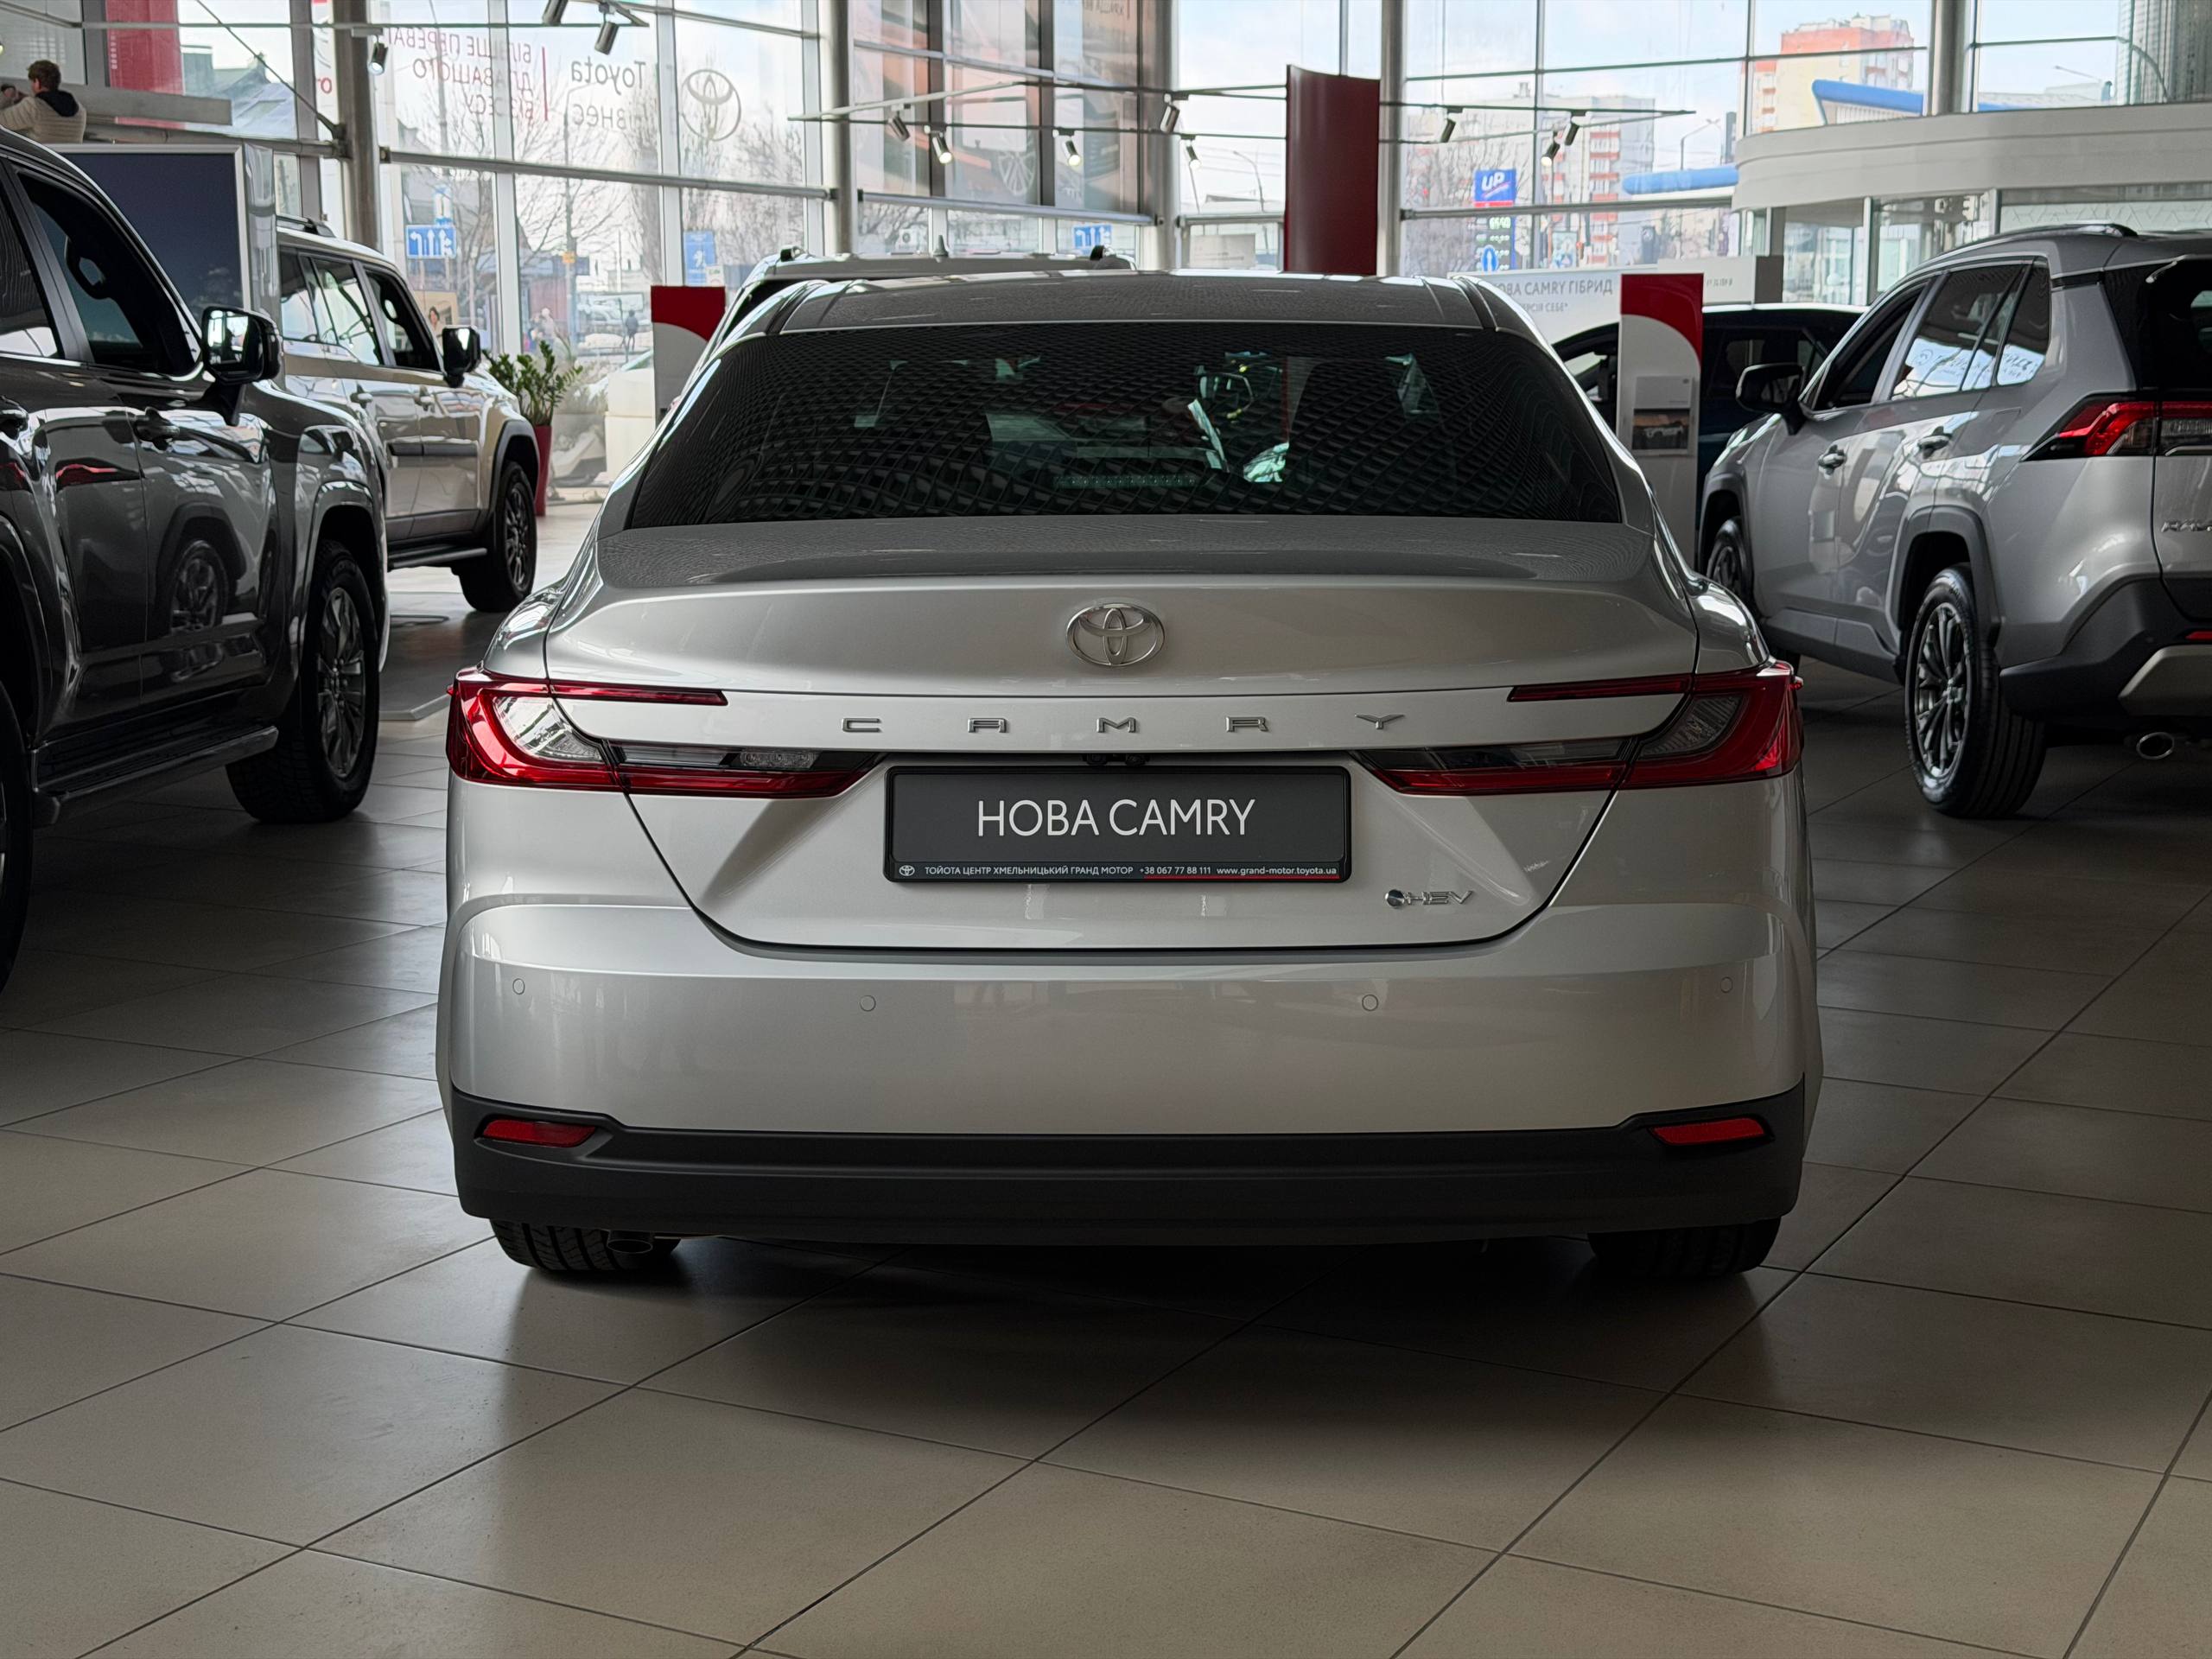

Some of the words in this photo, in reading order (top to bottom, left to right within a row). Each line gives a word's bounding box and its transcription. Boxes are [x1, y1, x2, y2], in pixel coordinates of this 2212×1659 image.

[1524, 280, 1567, 295] CAMRY
[1568, 278, 1613, 295] ГІБРИД
[842, 713, 1405, 734] CAMRY
[978, 799, 1100, 837] НОВА
[1109, 798, 1255, 836] CAMRY
[925, 865, 961, 875] ТОЙОТА
[963, 866, 992, 876] ЦЕНТР
[993, 865, 1069, 876] ХМЕЛЬНИЦЬКИЙ
[1071, 866, 1100, 876] ГРАНД
[1101, 866, 1134, 875] МОТОР
[1140, 866, 1155, 874] +38
[1156, 866, 1173, 874] 067
[1174, 866, 1185, 874] 77
[1186, 866, 1198, 874] 88
[1199, 866, 1211, 874] 111
[1216, 866, 1338, 876] www.grand-motor.toyota.ua
